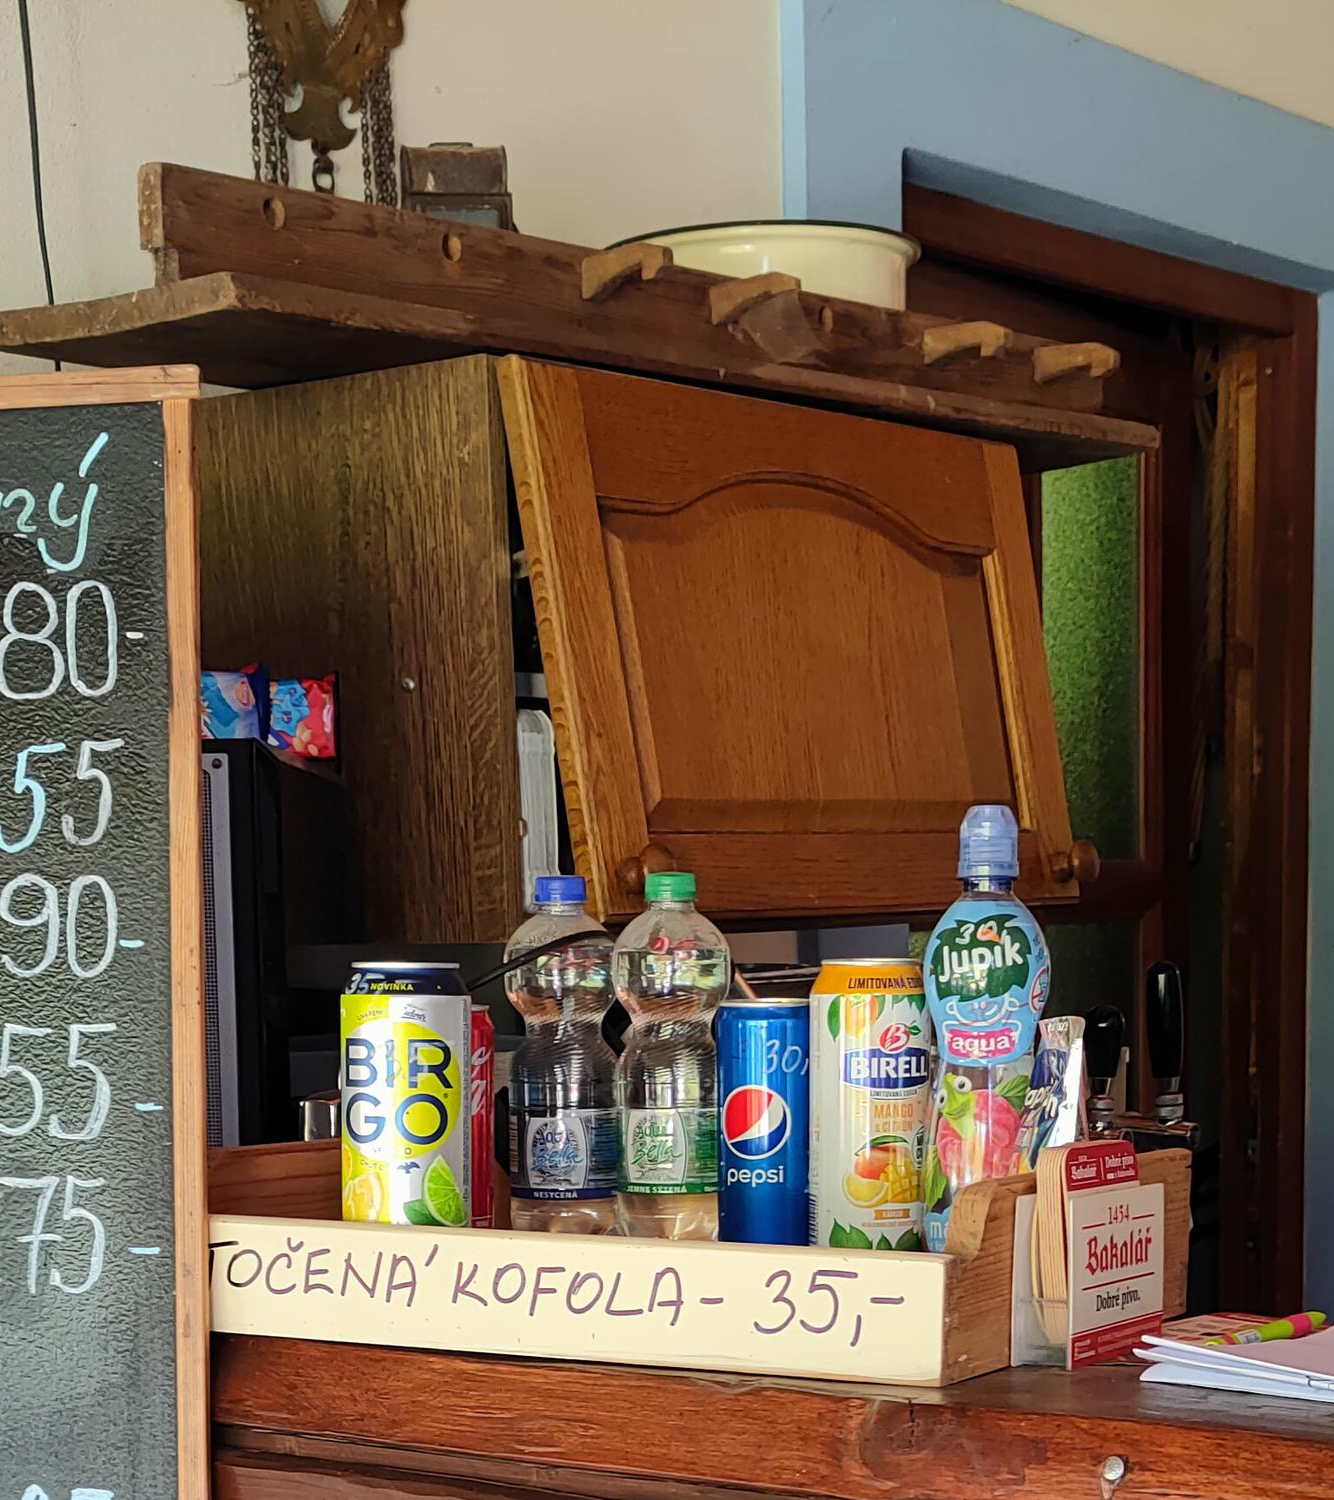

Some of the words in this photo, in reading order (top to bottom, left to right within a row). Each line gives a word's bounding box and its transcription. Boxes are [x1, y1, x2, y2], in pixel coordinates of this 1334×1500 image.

[370, 981, 415, 993] NOVINKA
[848, 975, 906, 989] LIMITOVANÁ
[951, 1034, 1011, 1056] aqua
[345, 1038, 453, 1089] BIR
[850, 1056, 927, 1079] BIRELL
[346, 1092, 448, 1145] GO
[874, 1103, 913, 1118] MANGO
[727, 1166, 784, 1188] pepsi
[1108, 1203, 1131, 1225] 1454
[1085, 1227, 1153, 1276] Bakalář
[208, 1236, 439, 1308] TOČENÁ
[1096, 1287, 1120, 1312] Dobré
